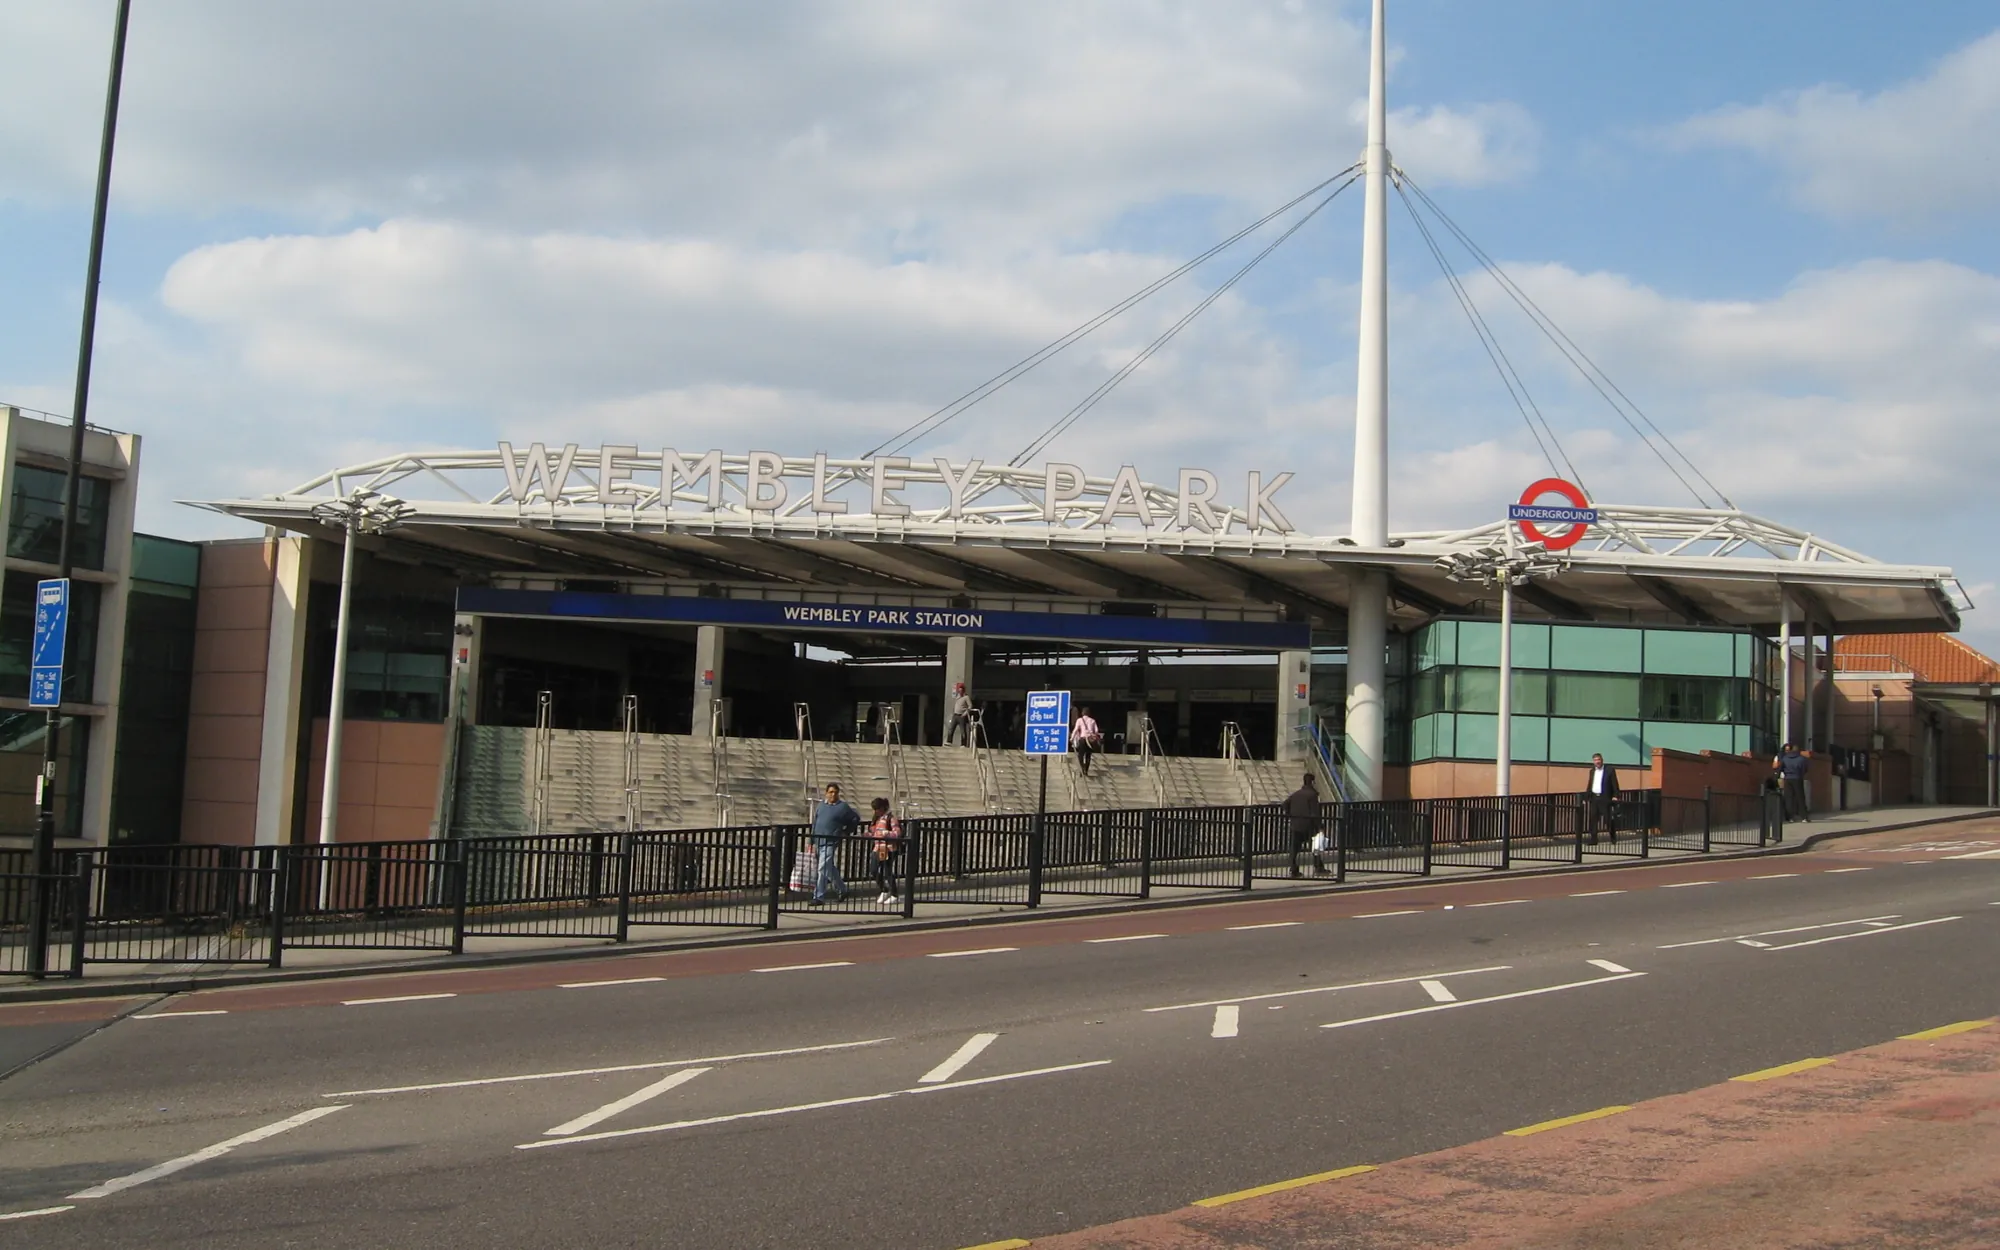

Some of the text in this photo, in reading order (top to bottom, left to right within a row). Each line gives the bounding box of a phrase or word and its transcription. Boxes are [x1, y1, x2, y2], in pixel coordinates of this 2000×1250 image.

[497, 441, 1296, 532] WEMBLEY PARK
[1512, 508, 1594, 520] UNDERGROUND
[784, 606, 983, 628] WEMBLEY PARK STATION
